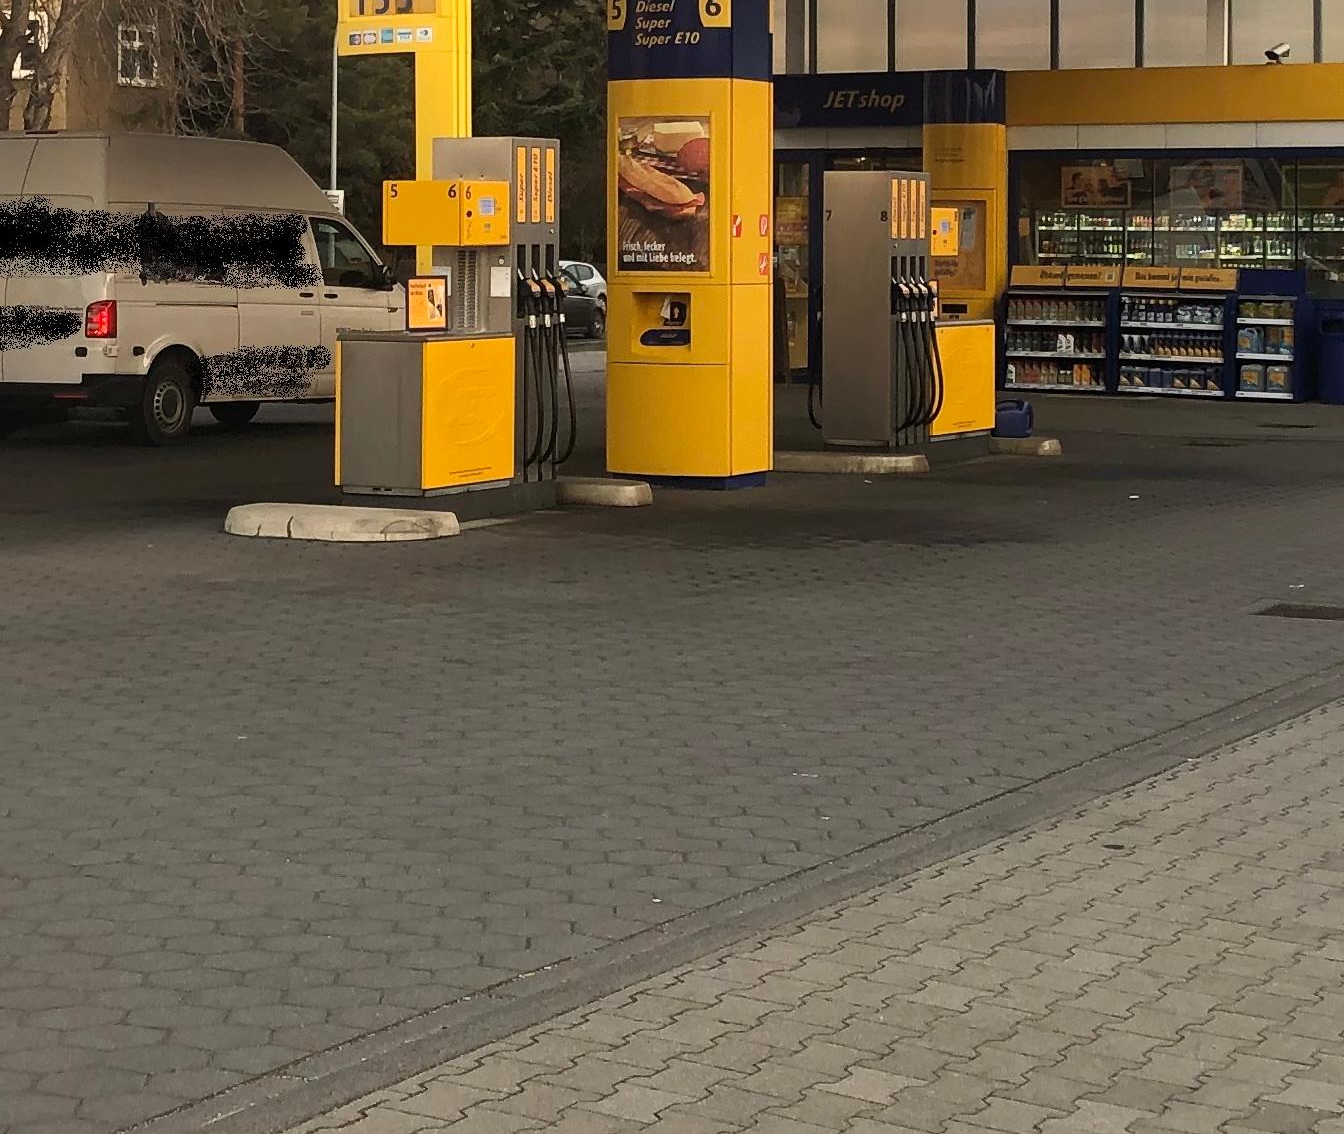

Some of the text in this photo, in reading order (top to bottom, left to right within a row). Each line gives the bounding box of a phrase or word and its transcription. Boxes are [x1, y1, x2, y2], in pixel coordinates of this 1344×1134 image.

[635, 0, 676, 13] Diesel
[635, 17, 671, 32] Super
[635, 31, 700, 48] Super E10
[389, 183, 457, 199] 5 6
[465, 185, 471, 200] 6
[880, 211, 888, 222] 8
[643, 240, 666, 251] lecker
[623, 251, 697, 264] und mit Liebe belegt.
